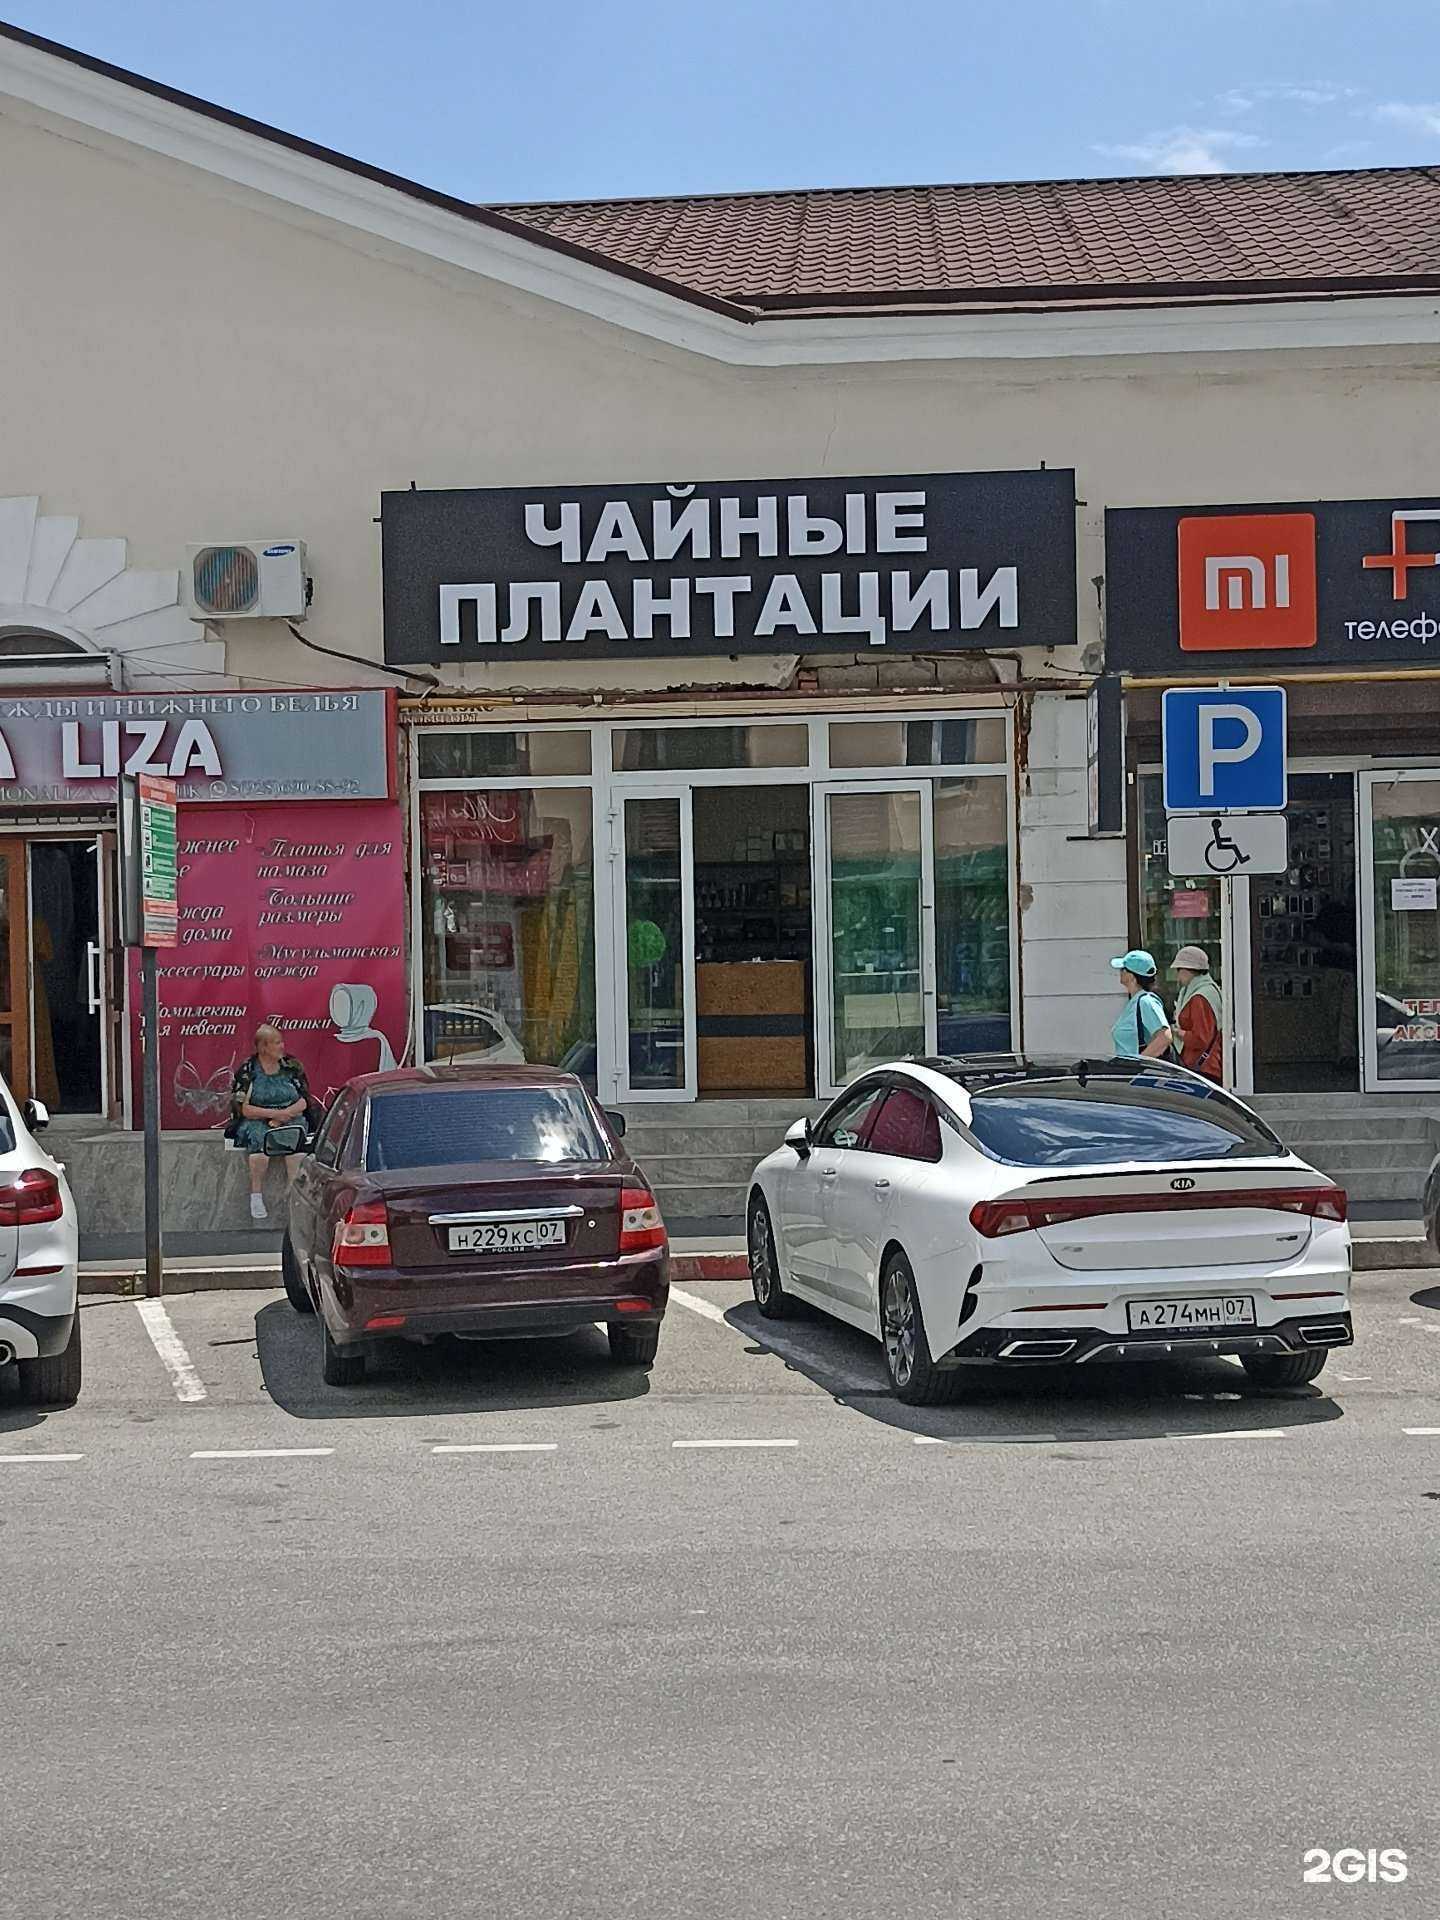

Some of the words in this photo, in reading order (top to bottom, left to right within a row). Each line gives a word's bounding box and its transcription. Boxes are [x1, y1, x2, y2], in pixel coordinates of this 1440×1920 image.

[525, 485, 929, 563] ЧАЙНЫЕ
[438, 566, 1020, 645] ПЛАНТАЦИИ
[1344, 611, 1440, 645] телеф
[87, 700, 105, 716] И
[115, 698, 263, 715] НИЖНЕГО
[270, 695, 360, 712] БЕЛЬЯ
[62, 718, 223, 779] LIZA
[1198, 703, 1263, 796] P
[177, 838, 239, 855] жнее
[257, 864, 328, 879] намаза
[258, 909, 343, 927] размеры
[183, 927, 233, 945] дома
[254, 964, 319, 980] одежда
[180, 1018, 237, 1036] невест
[1173, 1180, 1192, 1189] KIA
